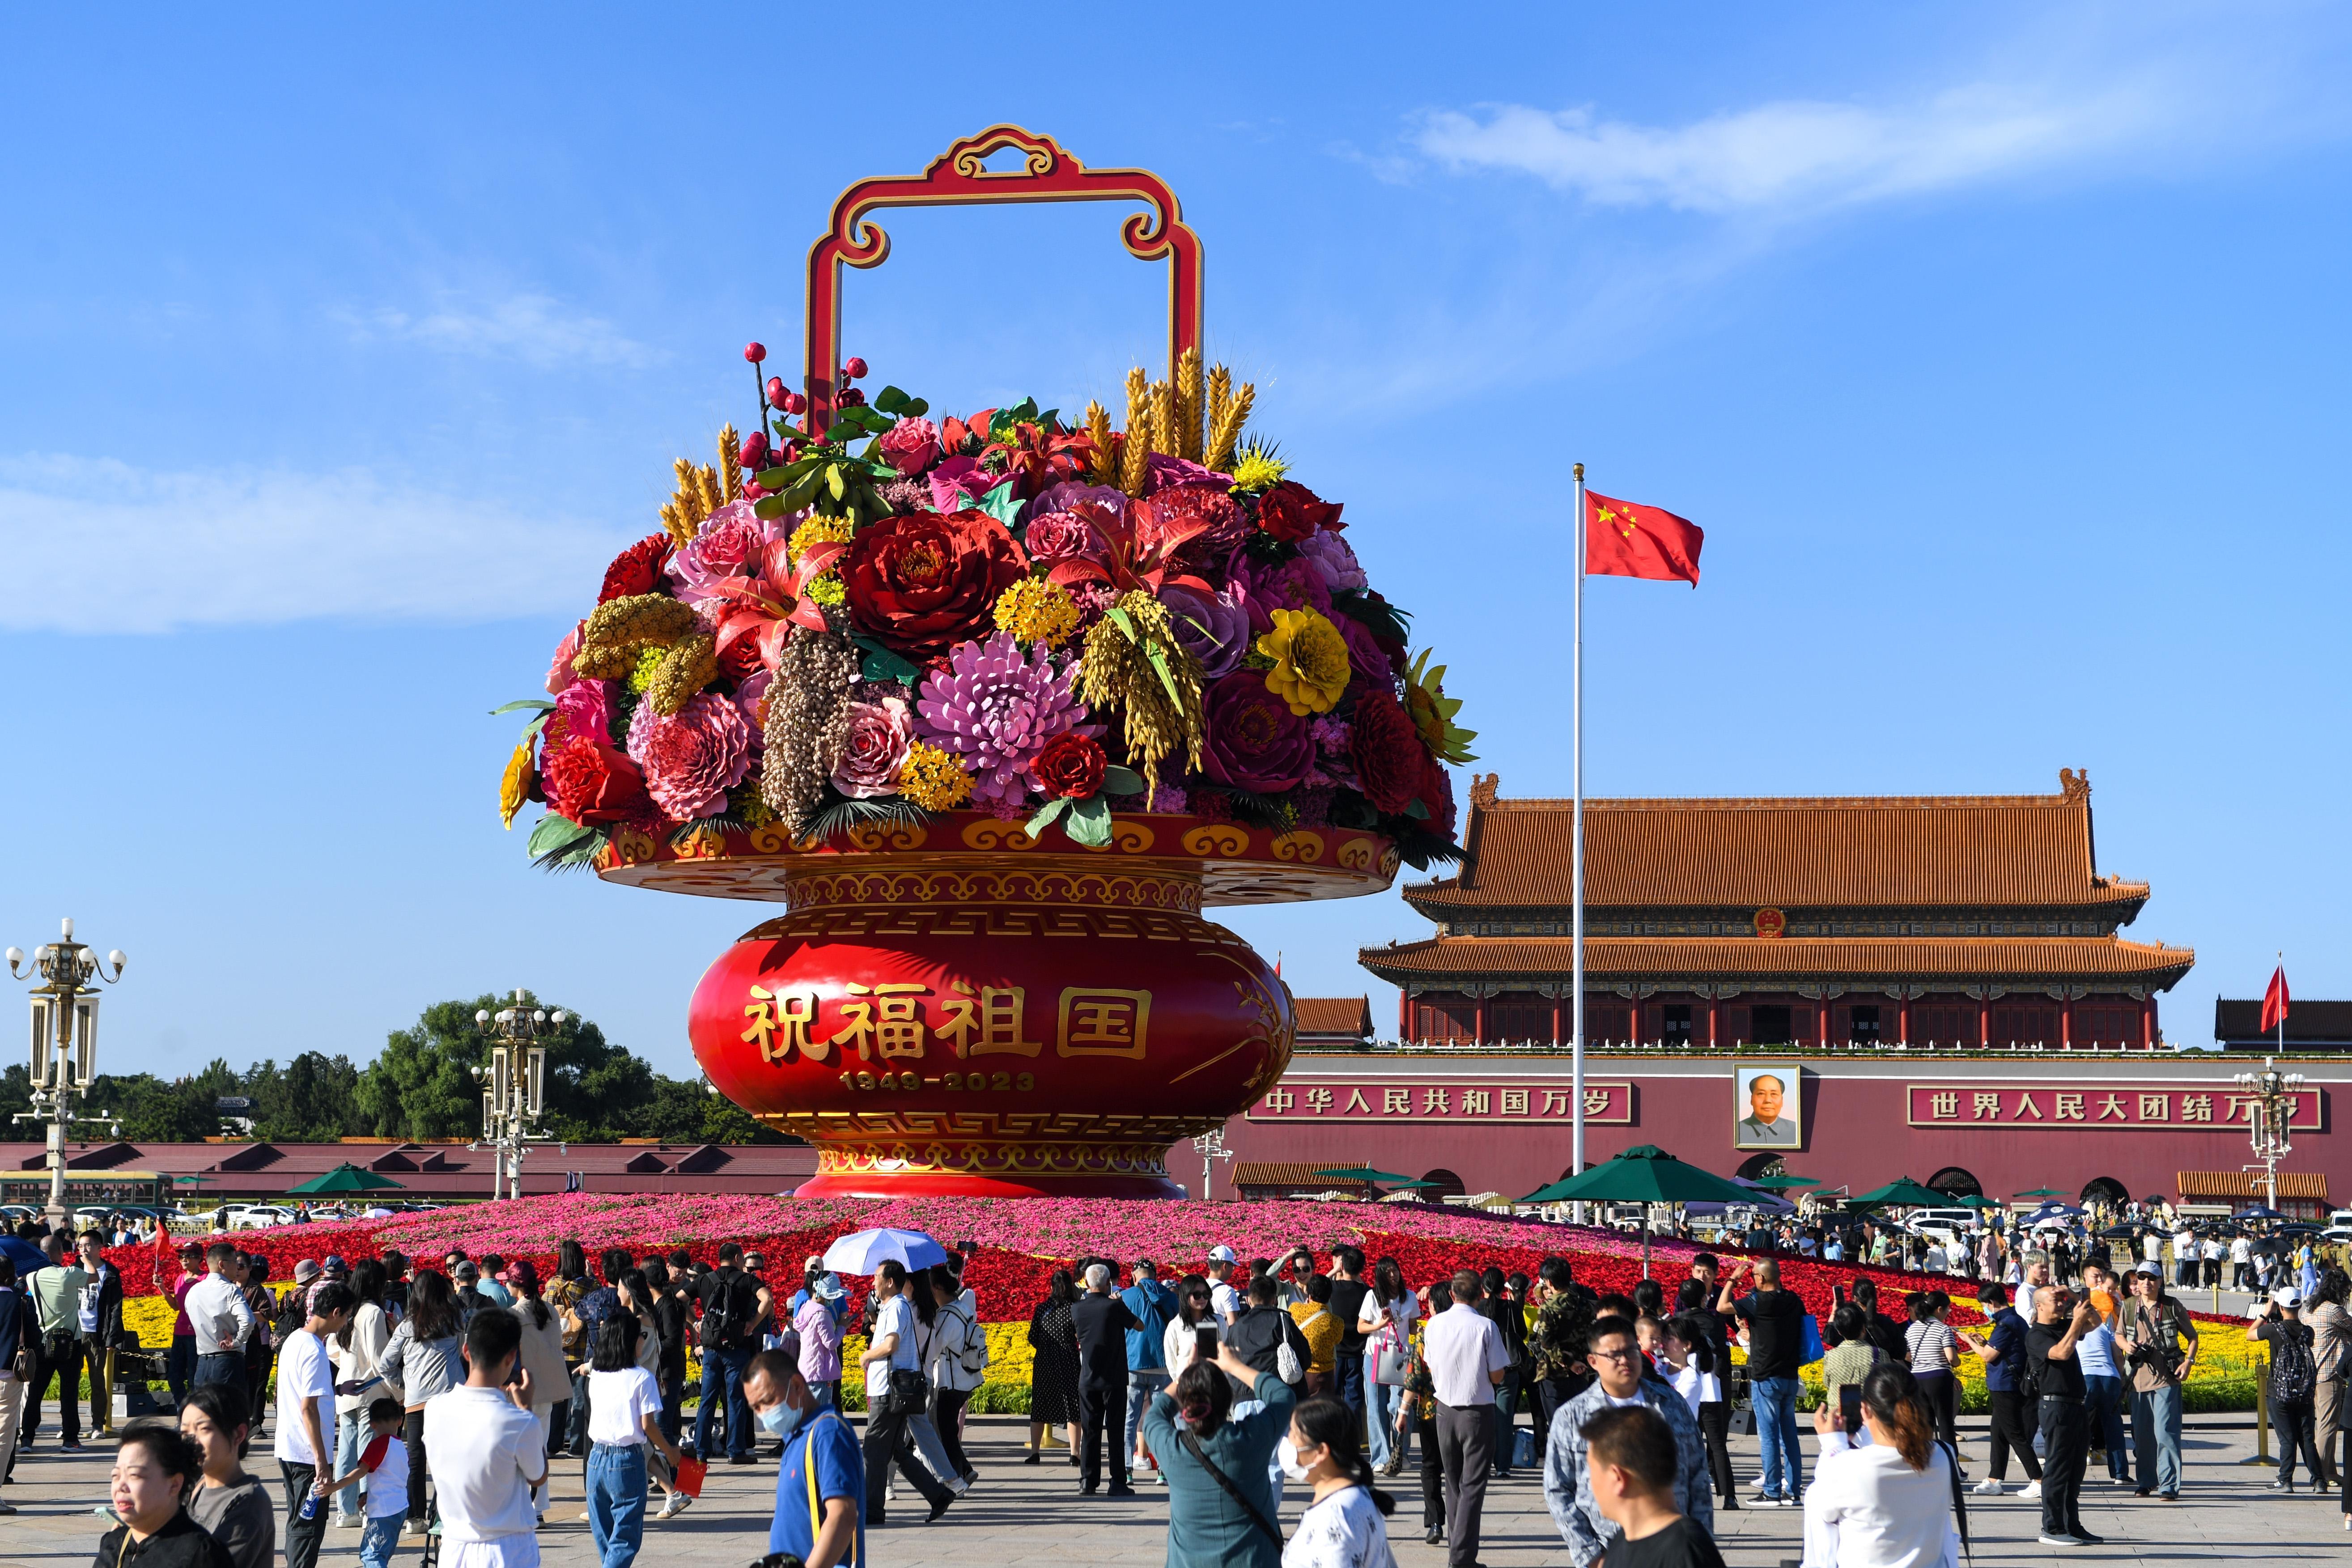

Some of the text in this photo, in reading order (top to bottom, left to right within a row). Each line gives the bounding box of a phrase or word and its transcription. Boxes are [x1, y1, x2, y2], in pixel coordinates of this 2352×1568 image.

[741, 981, 1152, 1063] 祝福祖国
[839, 1071, 1034, 1091] 1949-2023
[1265, 1088, 1609, 1115] 中华人民共和国万岁
